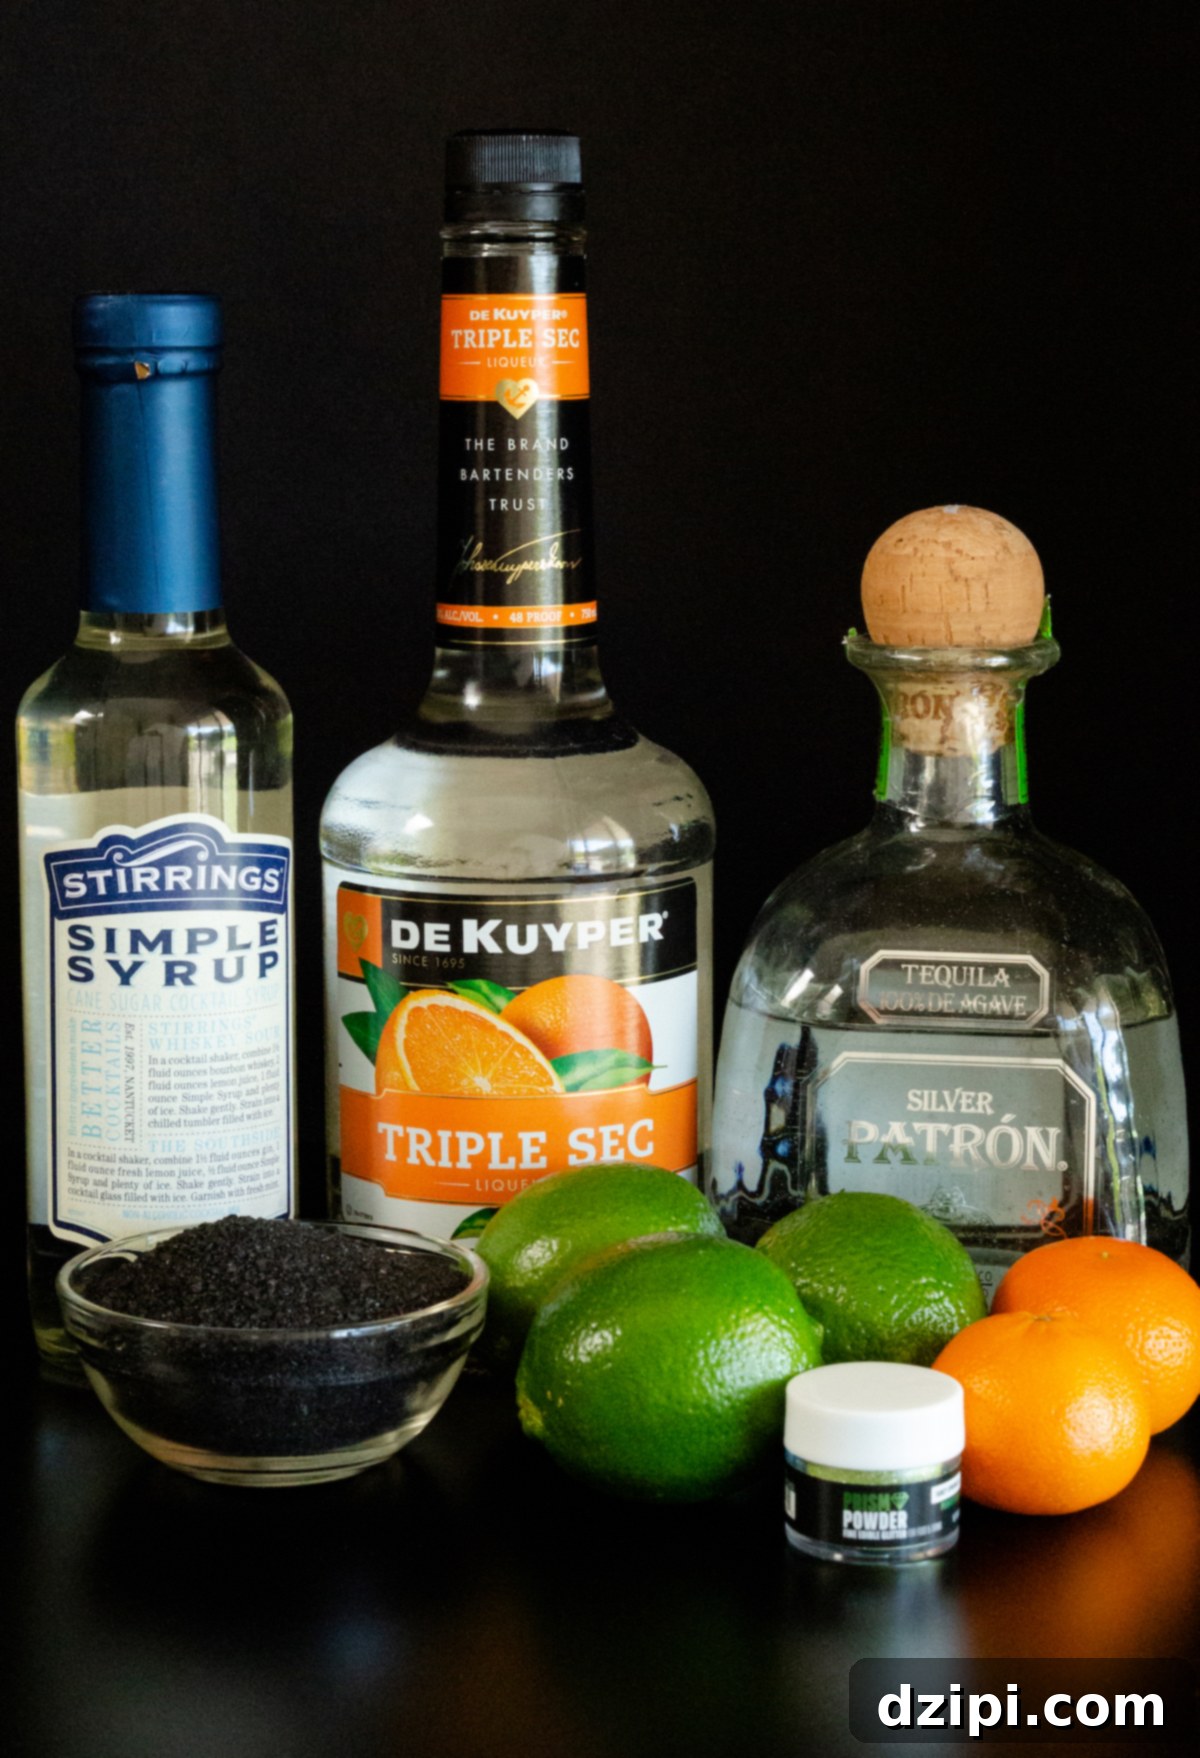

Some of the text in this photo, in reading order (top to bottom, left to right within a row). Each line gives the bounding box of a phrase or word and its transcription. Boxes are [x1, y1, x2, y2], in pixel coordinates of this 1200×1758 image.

[469, 309, 490, 321] DE
[451, 328, 580, 349] TRIPLE SEC
[486, 356, 546, 368] LIQUEUR
[465, 437, 569, 451] THE BRAND
[460, 467, 574, 481] BARTENDERS
[489, 498, 547, 511] TRUST
[509, 611, 523, 623] 48
[526, 609, 562, 622] PROOF
[67, 919, 278, 955] SIMPLE
[390, 918, 450, 952] DE
[67, 951, 279, 987] SYRUP
[391, 953, 466, 969] SINCE 1695
[901, 964, 1010, 988] TEQUILA
[67, 988, 101, 1009] CANE
[110, 992, 162, 1012] SUGAR
[169, 990, 240, 1011] COCKTAIL
[926, 992, 956, 1013] DE
[959, 993, 1027, 1016] AGAVE
[124, 1022, 135, 1041] Est.
[148, 1034, 236, 1051] WHISKEY
[148, 1055, 159, 1065] In
[168, 1053, 208, 1065] cocktail
[241, 1046, 272, 1059] combine
[80, 1019, 102, 1139] BETTER
[148, 1067, 171, 1078] fluid
[173, 1069, 208, 1077] ounces
[209, 1064, 246, 1076] bourbon
[105, 1021, 121, 1142] COCKTAILS
[148, 1080, 171, 1090] fluid
[173, 1082, 208, 1090] ounces
[210, 1078, 237, 1089] lemon
[147, 1095, 178, 1103] ounce
[181, 1091, 213, 1104] Simple
[217, 1089, 243, 1101] Syrup
[245, 1085, 260, 1096] and
[906, 1087, 994, 1115] SILVER
[124, 1076, 135, 1144] NANTUCKET
[147, 1105, 158, 1115] of
[179, 1104, 208, 1116] Shake
[240, 1098, 262, 1110] Strain
[147, 1118, 181, 1128] chilled
[183, 1116, 220, 1128] tumbler
[222, 1112, 245, 1124] filled
[246, 1109, 262, 1121] with
[148, 1139, 185, 1153] THE
[377, 1118, 654, 1170] TRIPLE SEC
[83, 1151, 116, 1164] cocktail
[153, 1155, 193, 1165] combine
[209, 1151, 230, 1163] fluid
[231, 1148, 260, 1161] ounces
[67, 1159, 87, 1172] fluid
[88, 1165, 115, 1175] ounce
[117, 1166, 143, 1177] fresh
[145, 1167, 176, 1178] lemon
[217, 1163, 236, 1175] fluid
[237, 1160, 260, 1171] ounce
[67, 1172, 90, 1187] Syrup
[92, 1177, 108, 1188] and
[111, 1179, 138, 1191] plenty
[143, 1180, 153, 1191] of
[176, 1179, 204, 1191] Shake
[238, 1173, 261, 1184] Strain
[475, 1178, 537, 1193] LIQUE
[67, 1187, 99, 1199] cocktail
[100, 1190, 122, 1202] glass
[124, 1191, 148, 1202] filled
[150, 1192, 171, 1203] with
[191, 1189, 226, 1202] Garnish
[227, 1186, 245, 1198] with
[246, 1182, 264, 1195] fresh
[842, 1509, 908, 1531] POWDER
